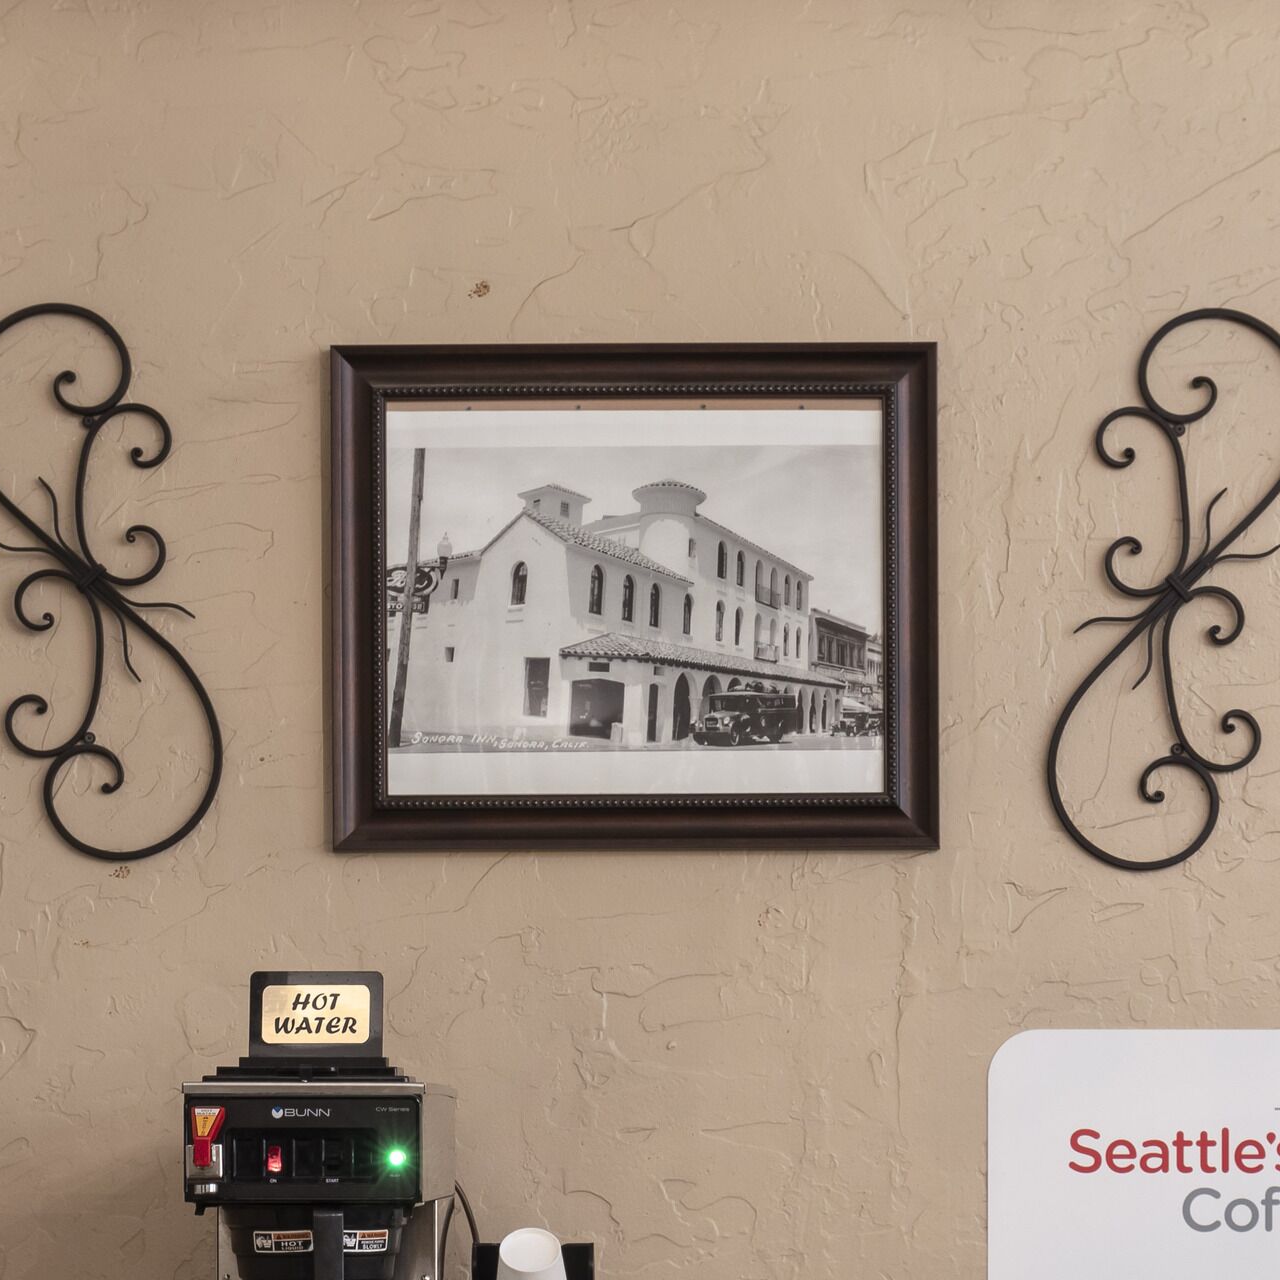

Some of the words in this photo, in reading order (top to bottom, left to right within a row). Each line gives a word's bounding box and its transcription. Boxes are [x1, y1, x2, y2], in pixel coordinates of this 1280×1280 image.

[292, 993, 340, 1010] HOT
[275, 1017, 357, 1034] WATER
[285, 1108, 330, 1117] BUNN
